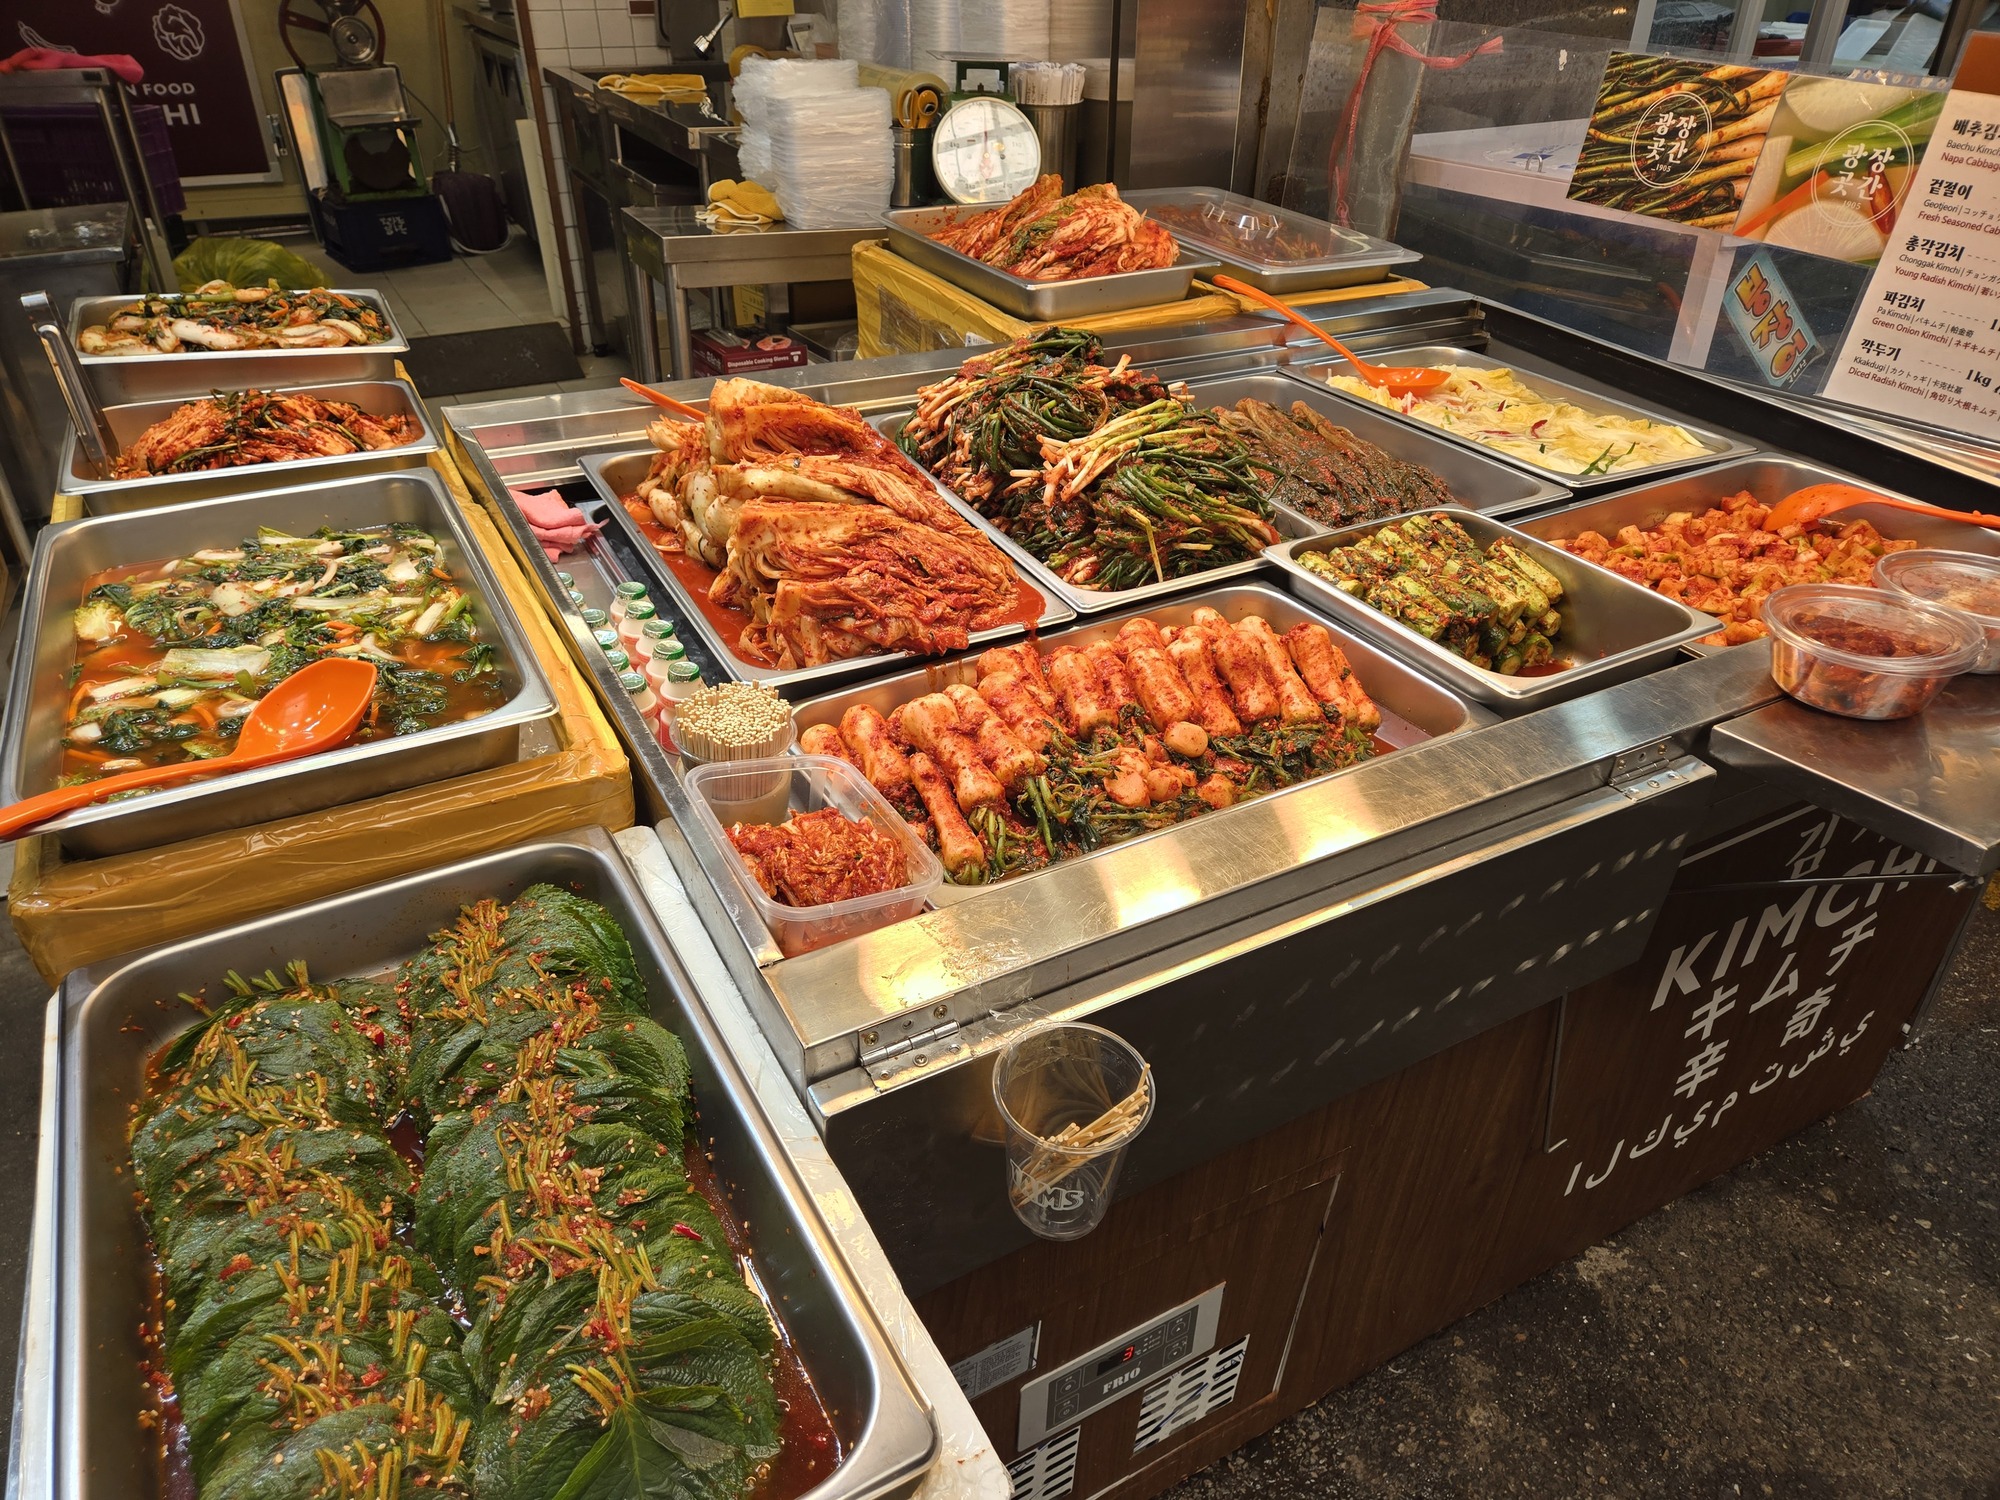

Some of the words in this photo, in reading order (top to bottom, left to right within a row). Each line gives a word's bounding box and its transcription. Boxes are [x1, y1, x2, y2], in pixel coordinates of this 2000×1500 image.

[142, 82, 196, 96] FOOD
[1655, 111, 1697, 139] 광장
[1952, 119, 2000, 141] 배추김
[1646, 137, 1689, 164] 곳간
[1946, 139, 1976, 152] Baechu
[1842, 143, 1895, 173] 광장
[1941, 152, 1964, 165] Napa
[1830, 170, 1883, 201] 곳간
[1923, 199, 1960, 213] Geotjeori
[1917, 210, 1941, 223] Fresh
[1941, 215, 1984, 232] Seasoned
[1905, 235, 1966, 262] 총각김치
[1898, 253, 1936, 269] Chonggak
[1935, 261, 1962, 275] Kimchi
[1894, 265, 1920, 280] Young
[1920, 272, 1947, 286] Radish
[1947, 278, 1976, 293] Kimchi
[1883, 290, 1926, 312] 파김치
[1876, 306, 1886, 315] Pa
[1886, 308, 1912, 321] Kimchi
[1871, 317, 1895, 330] Green
[1896, 323, 1921, 337] Onion
[1920, 330, 1949, 344] Kimchi
[1860, 338, 1902, 362] 깍두기
[1853, 355, 1887, 373] Kkakdugi
[1848, 366, 1871, 380] Diced
[1870, 373, 1897, 388] Radish
[1897, 381, 1926, 397] Kimchi
